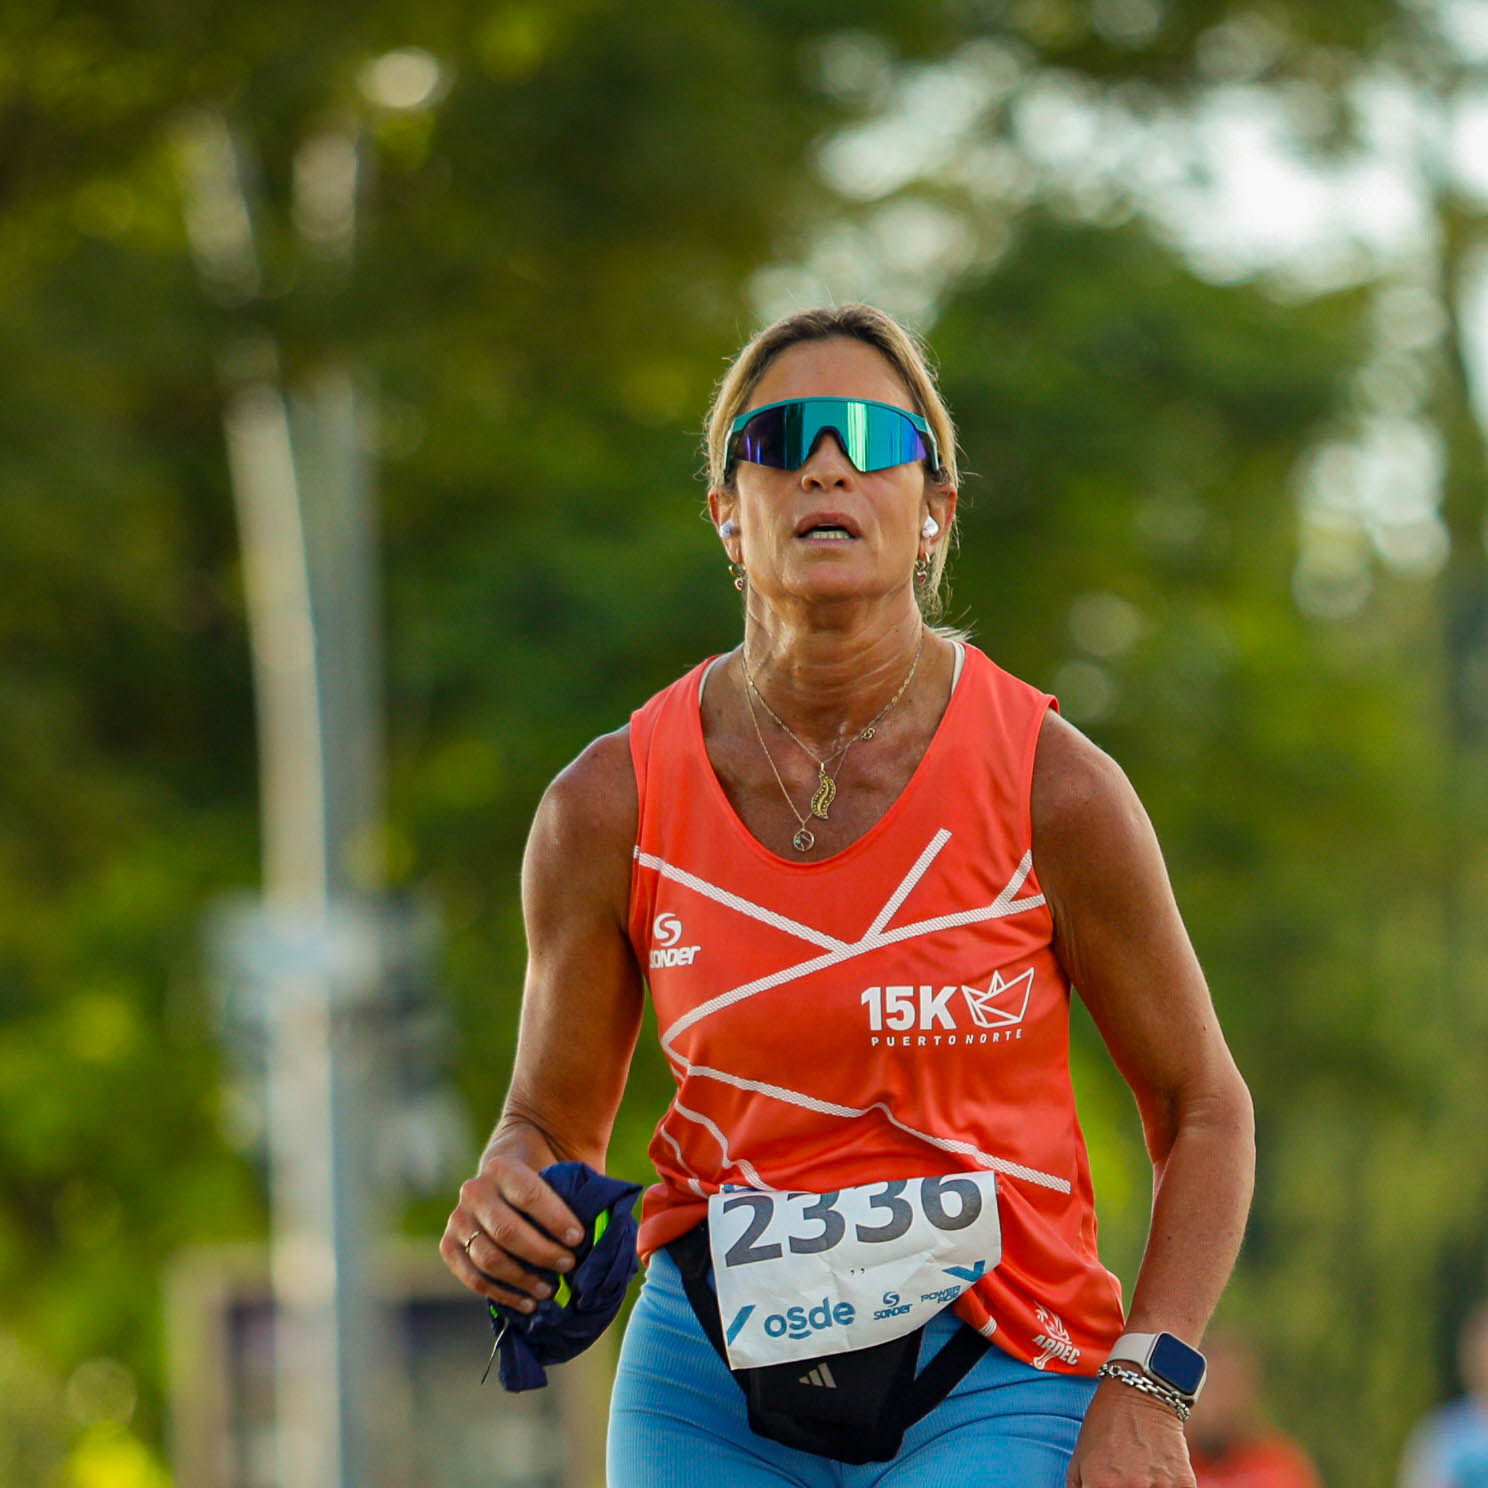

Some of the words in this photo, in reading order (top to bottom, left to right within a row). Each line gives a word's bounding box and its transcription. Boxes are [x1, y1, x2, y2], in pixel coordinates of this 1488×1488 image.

[861, 985, 958, 1031] 15K
[871, 1035, 957, 1047] PUERTO
[965, 1028, 1023, 1045] NORTE
[723, 1176, 983, 1268] 2336
[764, 1296, 856, 1339] osde
